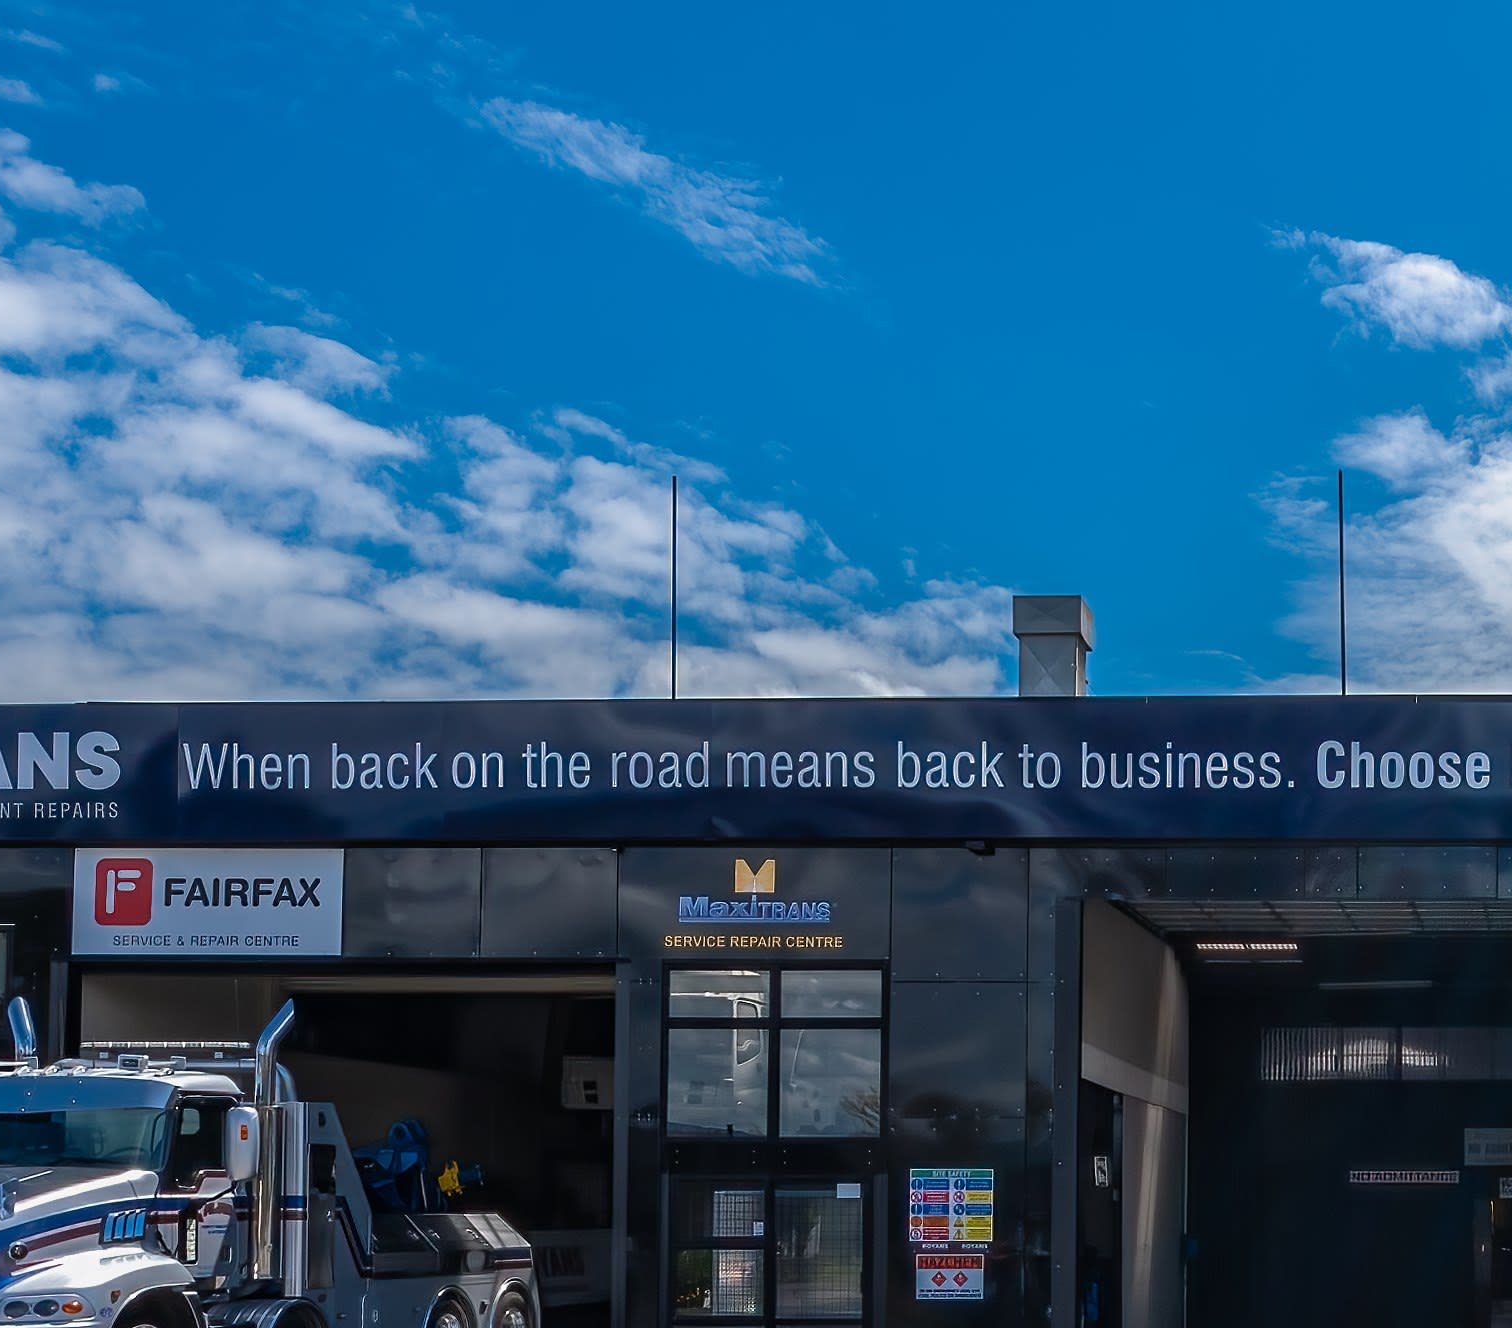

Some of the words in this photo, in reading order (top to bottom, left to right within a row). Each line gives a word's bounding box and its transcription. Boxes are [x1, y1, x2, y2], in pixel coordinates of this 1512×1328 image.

[183, 742, 311, 789] When
[330, 742, 438, 789] back
[452, 748, 504, 789] on
[522, 742, 591, 789] the
[611, 741, 709, 789] road
[727, 747, 875, 788] means
[896, 740, 1004, 790] back
[1019, 745, 1061, 790] to
[1081, 741, 1295, 790] business.
[1316, 740, 1491, 791] Choose
[34, 802, 119, 819] REPAIRS
[163, 877, 321, 907] FAIRFAX
[112, 935, 171, 946] SERVICE
[176, 935, 185, 946] &
[190, 935, 239, 946] REPAIR
[244, 935, 300, 947] CENTRE
[664, 935, 726, 947] SERVICE
[730, 936, 781, 947] REPAIR
[786, 936, 843, 948] CENTRE
